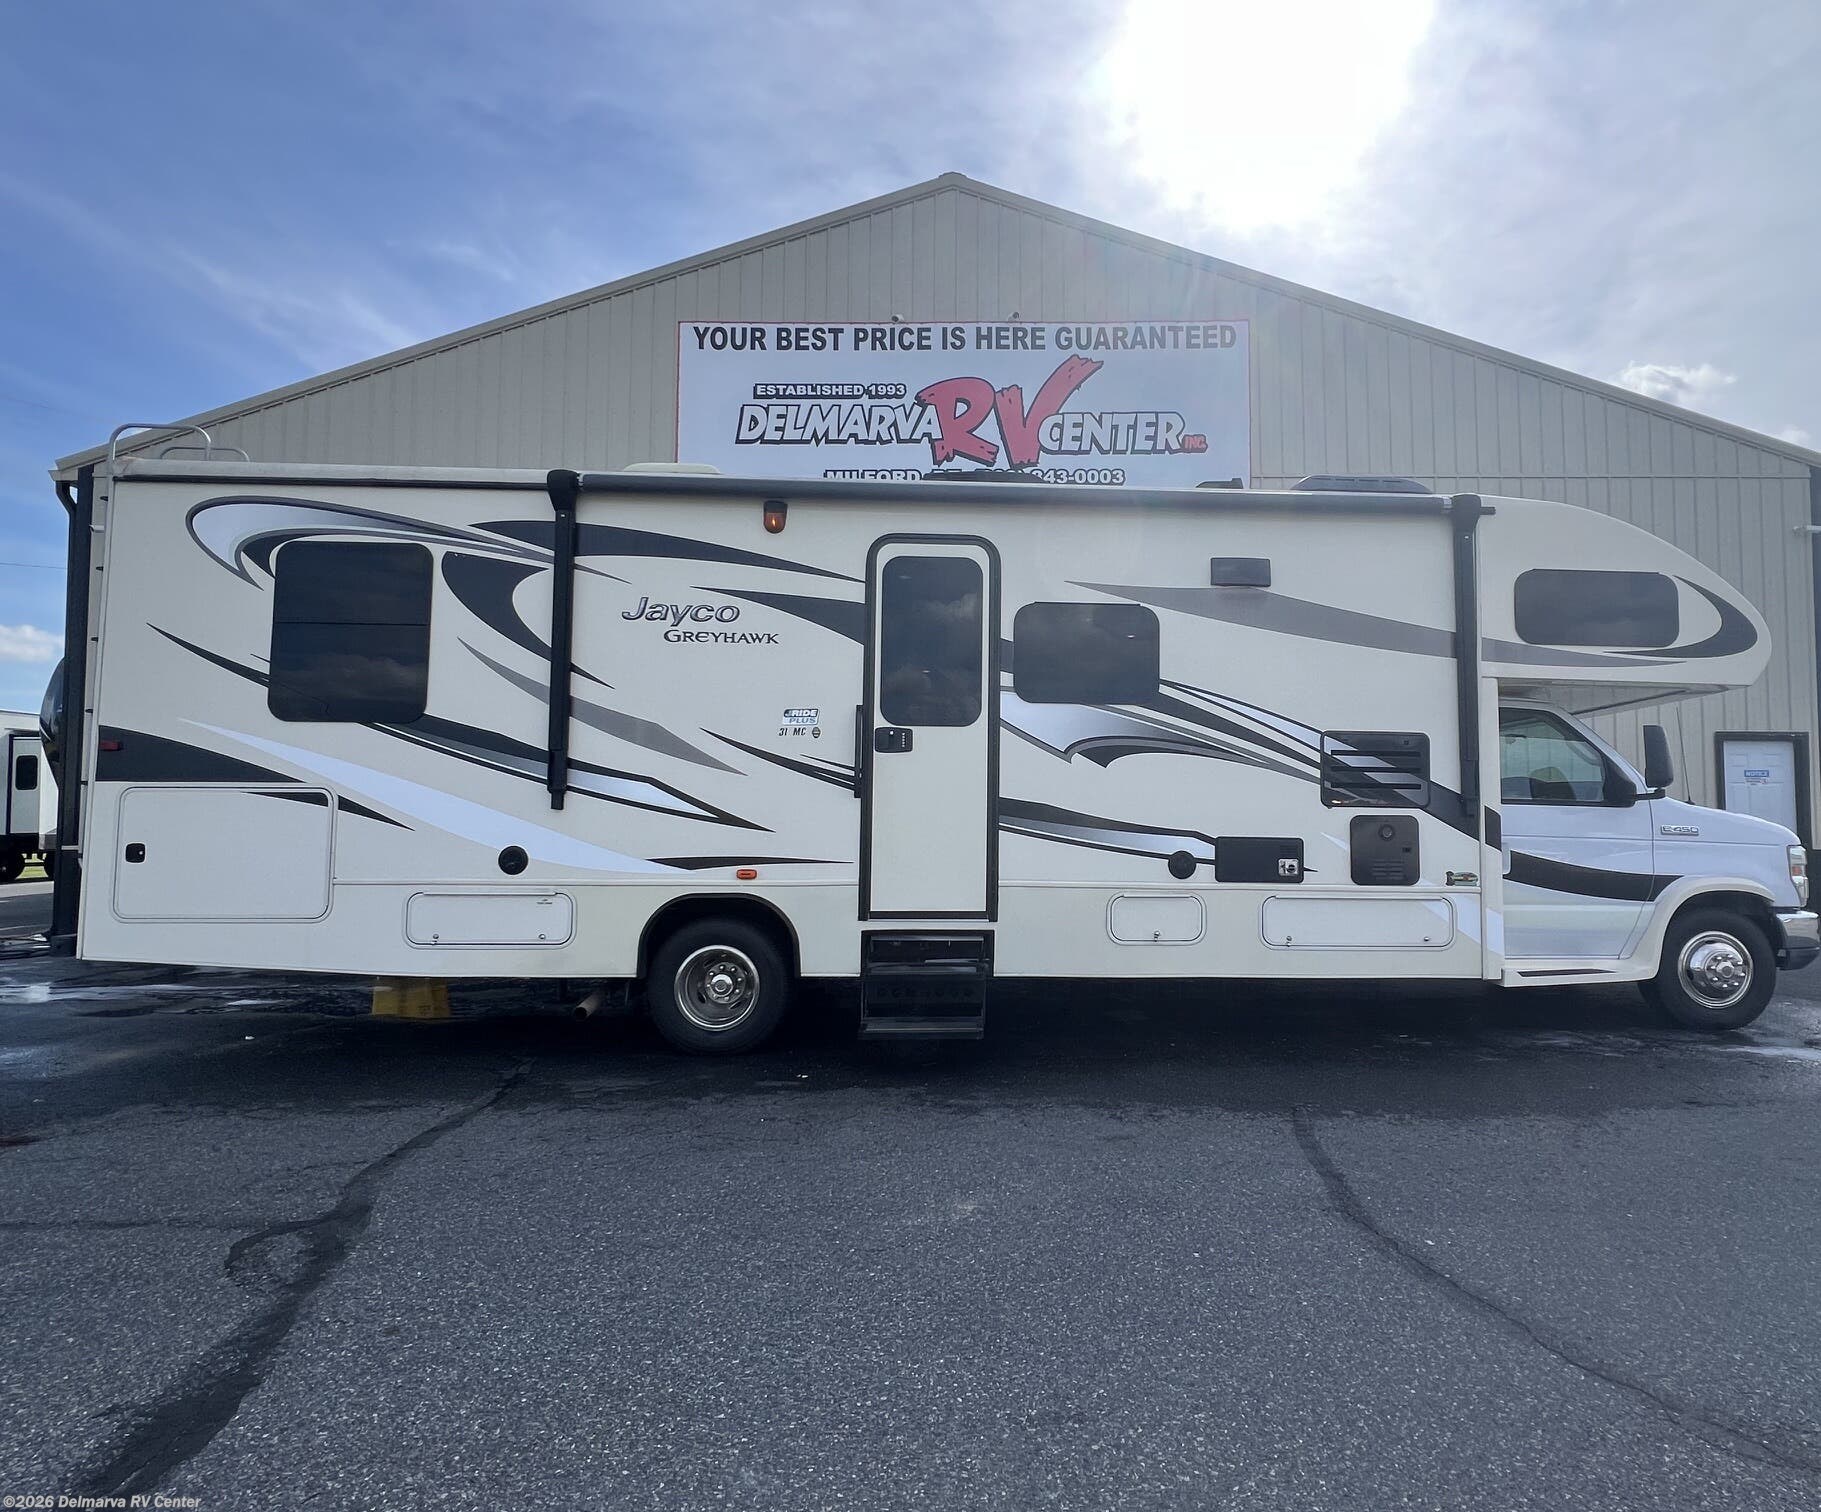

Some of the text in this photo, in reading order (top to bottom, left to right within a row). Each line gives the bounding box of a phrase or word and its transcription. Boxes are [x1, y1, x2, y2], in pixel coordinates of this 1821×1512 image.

[693, 325, 1237, 351] YOUR BEST PRICE IS HERE GUARANTEED
[754, 384, 907, 398] ESTABLISHED 1993
[735, 404, 944, 446] DELMARVA
[915, 354, 1104, 470] RV
[1037, 411, 1186, 456] CENTER
[621, 597, 741, 626] Jayco
[663, 629, 780, 645] GREYHAWK
[779, 727, 806, 737] 31 MC
